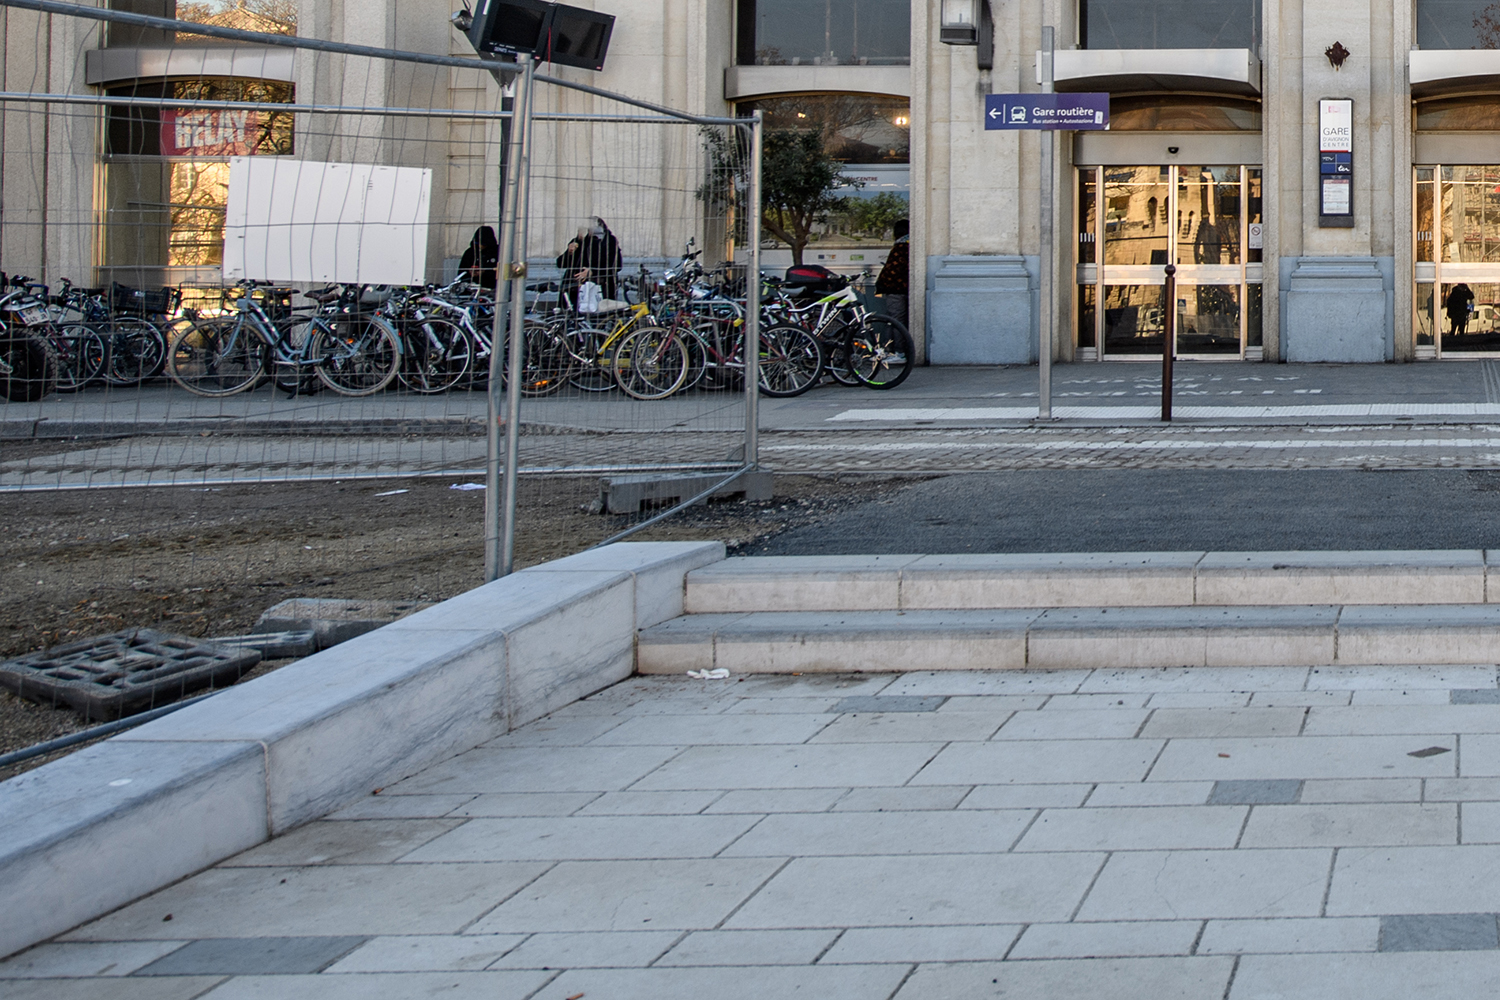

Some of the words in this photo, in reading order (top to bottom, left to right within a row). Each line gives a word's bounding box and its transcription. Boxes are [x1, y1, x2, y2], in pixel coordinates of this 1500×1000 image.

[1032, 107, 1055, 116] Gare
[1057, 107, 1094, 116] routière
[175, 110, 249, 149] RELAY
[1323, 127, 1349, 135] GARE
